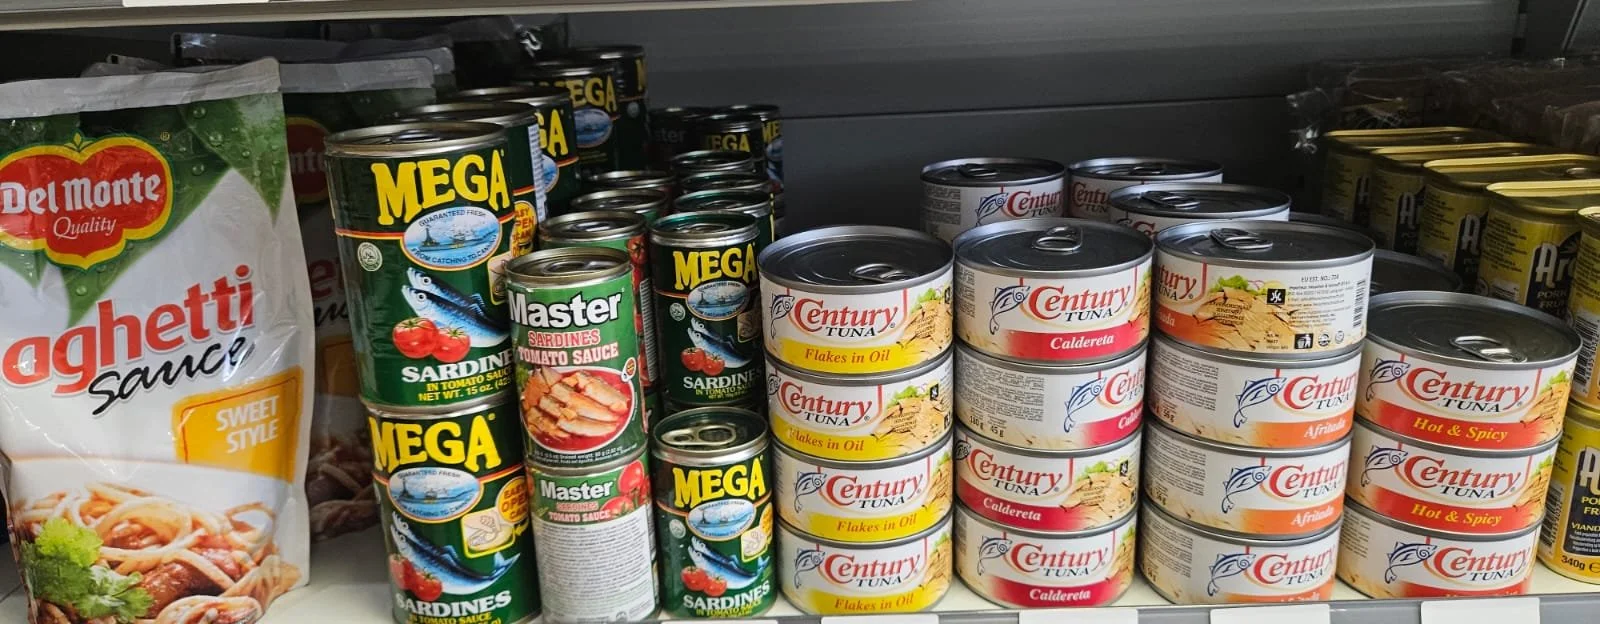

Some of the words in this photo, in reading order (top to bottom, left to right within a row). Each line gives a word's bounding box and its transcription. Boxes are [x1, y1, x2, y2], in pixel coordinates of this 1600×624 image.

[1, 181, 59, 215] Del
[64, 171, 162, 212] Monte
[371, 149, 511, 226] MEGA
[1072, 181, 1109, 208] Centu
[53, 216, 117, 240] Quality
[418, 209, 466, 227] GUARANTEED
[432, 256, 467, 265] CATCHING
[672, 243, 759, 291] MEGA
[507, 289, 623, 329] Master
[1028, 285, 1131, 321] Century
[1065, 307, 1114, 322] TUNA
[794, 298, 899, 334] Century
[528, 329, 600, 348] SARDINES
[825, 326, 876, 338] TUNA
[1050, 333, 1115, 350] Caldereta
[518, 345, 568, 366] TOMATO
[572, 342, 619, 365] SAUCE
[804, 348, 847, 364] Flakes
[851, 349, 865, 364] in
[869, 348, 890, 363] Oil
[88, 336, 256, 416] sauce
[426, 381, 440, 392] IN
[441, 375, 485, 390] TOMATO
[418, 390, 439, 401] NET
[442, 387, 463, 399] WT.
[467, 384, 478, 396] 15
[1406, 367, 1530, 411] Century
[780, 381, 873, 424] Century
[1316, 392, 1351, 410] TUNA
[1441, 397, 1501, 413] TUNA
[216, 395, 280, 432] SWEET
[803, 410, 850, 427] TUNA
[227, 419, 279, 454] STYLE
[788, 428, 824, 448] Flakes
[826, 437, 839, 450] in
[842, 439, 865, 452] Oil
[1303, 419, 1346, 439] Afritada
[1413, 417, 1442, 434] Hot
[1447, 424, 1461, 437] &
[1466, 427, 1508, 441] Spicy
[369, 414, 502, 474] MEGA
[969, 448, 1063, 494] Century
[1404, 455, 1522, 496] Century
[540, 479, 614, 501] Master
[672, 457, 766, 509] MEGA
[826, 473, 924, 507] Century
[993, 479, 1040, 496] TUNA
[1302, 481, 1339, 498] TUNA
[1439, 485, 1495, 499] TUNA
[858, 495, 905, 509] TUNA
[983, 496, 1042, 521] Caldereta
[549, 511, 580, 523] TOMATO
[582, 510, 611, 522] SAUCE
[836, 520, 880, 533] Flakes
[883, 519, 896, 531] in
[899, 513, 917, 528] Oil
[1291, 505, 1335, 527] Afritada
[1411, 503, 1441, 519] Hot
[1445, 511, 1458, 523] &
[1463, 512, 1502, 527] Spicy
[824, 553, 921, 585] Century
[1010, 542, 1109, 573] Century
[1433, 547, 1531, 578] Century
[1561, 554, 1586, 571] 340g
[855, 575, 903, 588] TUNA
[1042, 567, 1093, 577] TUNA
[1286, 570, 1324, 586] TUNA
[1469, 568, 1515, 582] TUNA
[395, 590, 513, 618] SARDINES
[683, 579, 771, 611] SARDINES
[834, 599, 876, 611] Flakes
[880, 598, 892, 610] in
[896, 593, 914, 606] Oil
[1029, 588, 1091, 601] Caldereta
